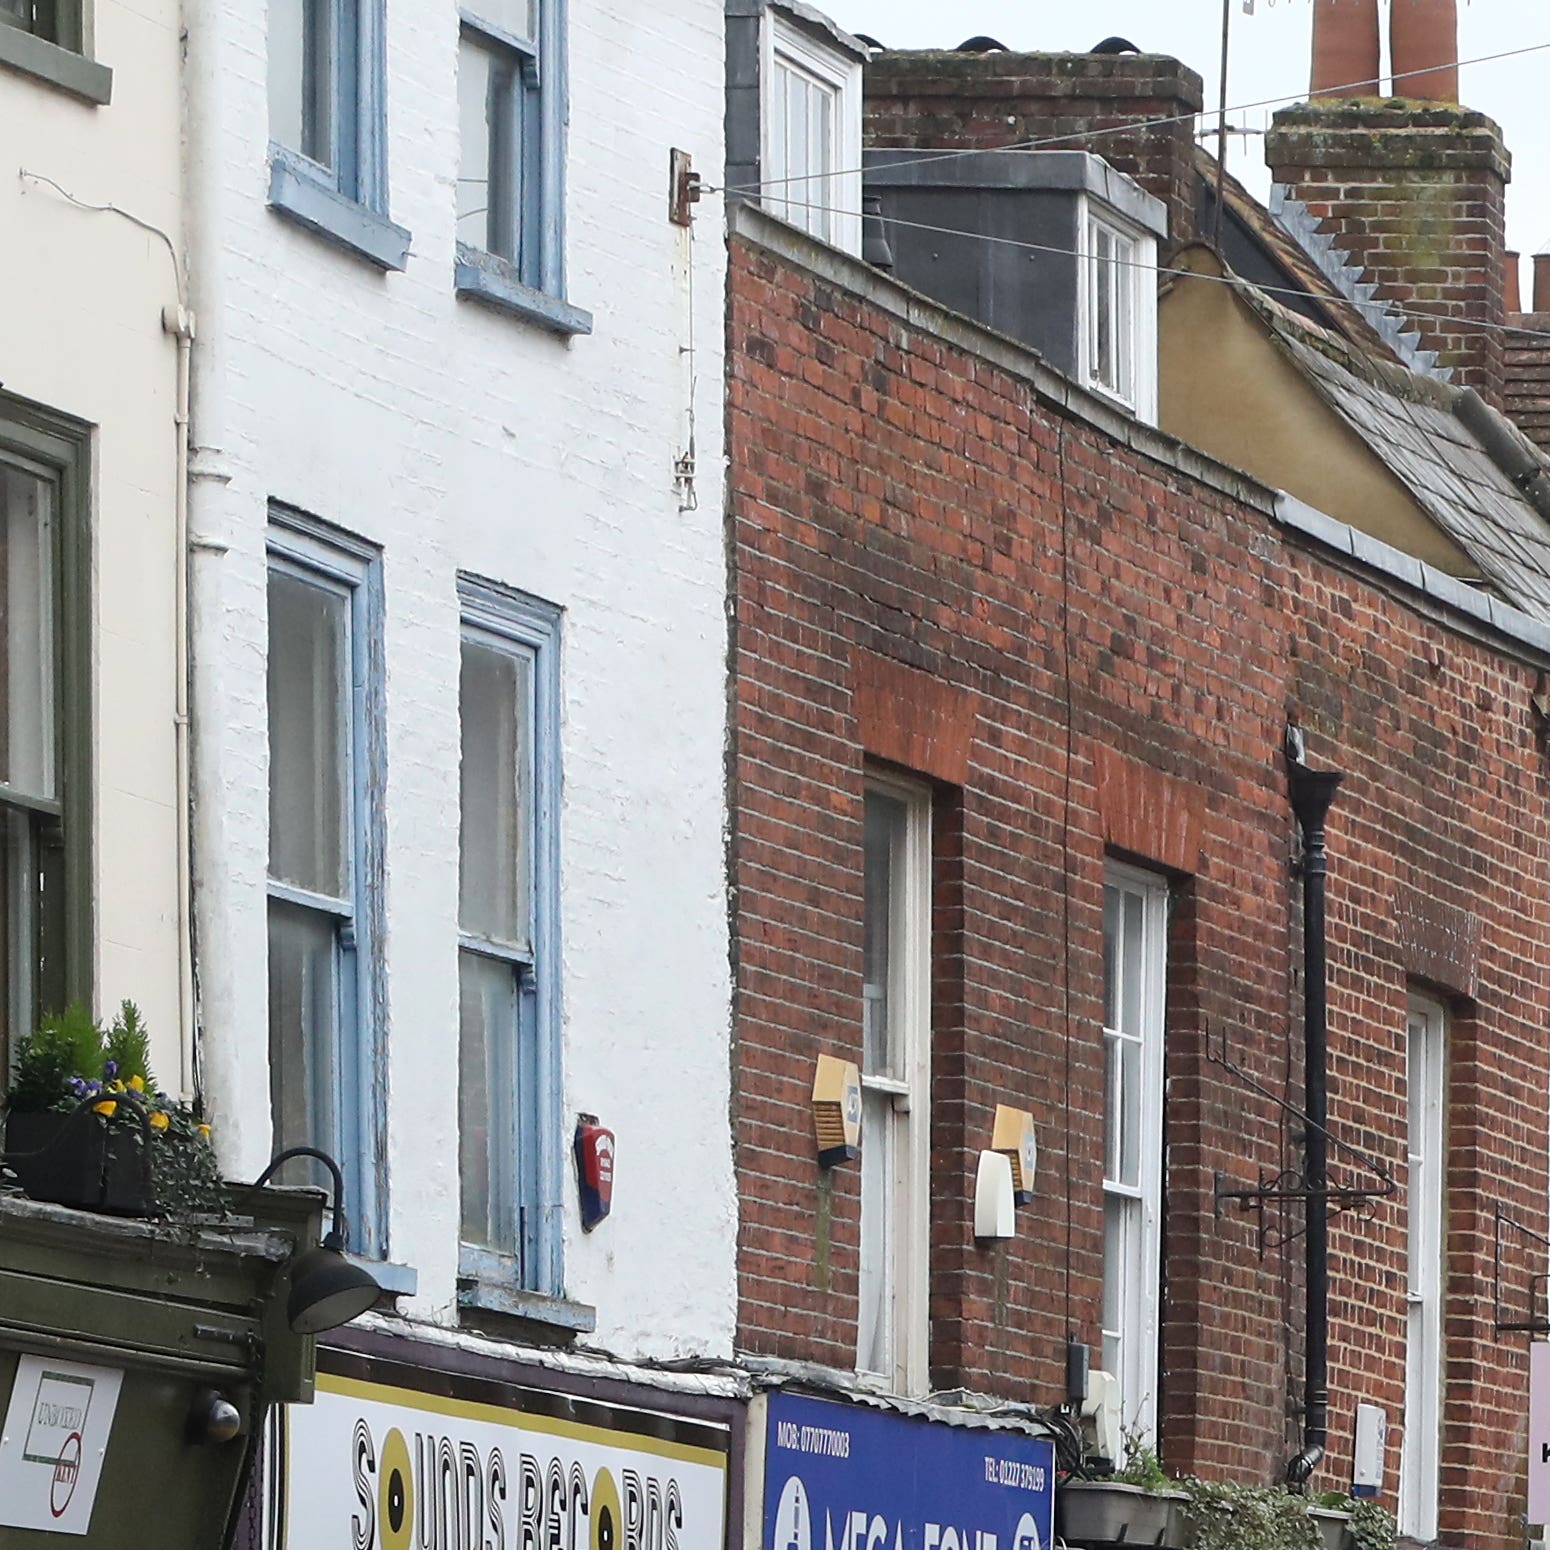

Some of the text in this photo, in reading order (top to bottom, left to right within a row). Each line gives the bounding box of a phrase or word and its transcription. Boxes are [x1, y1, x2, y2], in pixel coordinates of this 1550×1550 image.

[777, 1421, 800, 1450] MOB:
[984, 1456, 998, 1483] TEL:
[999, 1459, 1019, 1488] 01227
